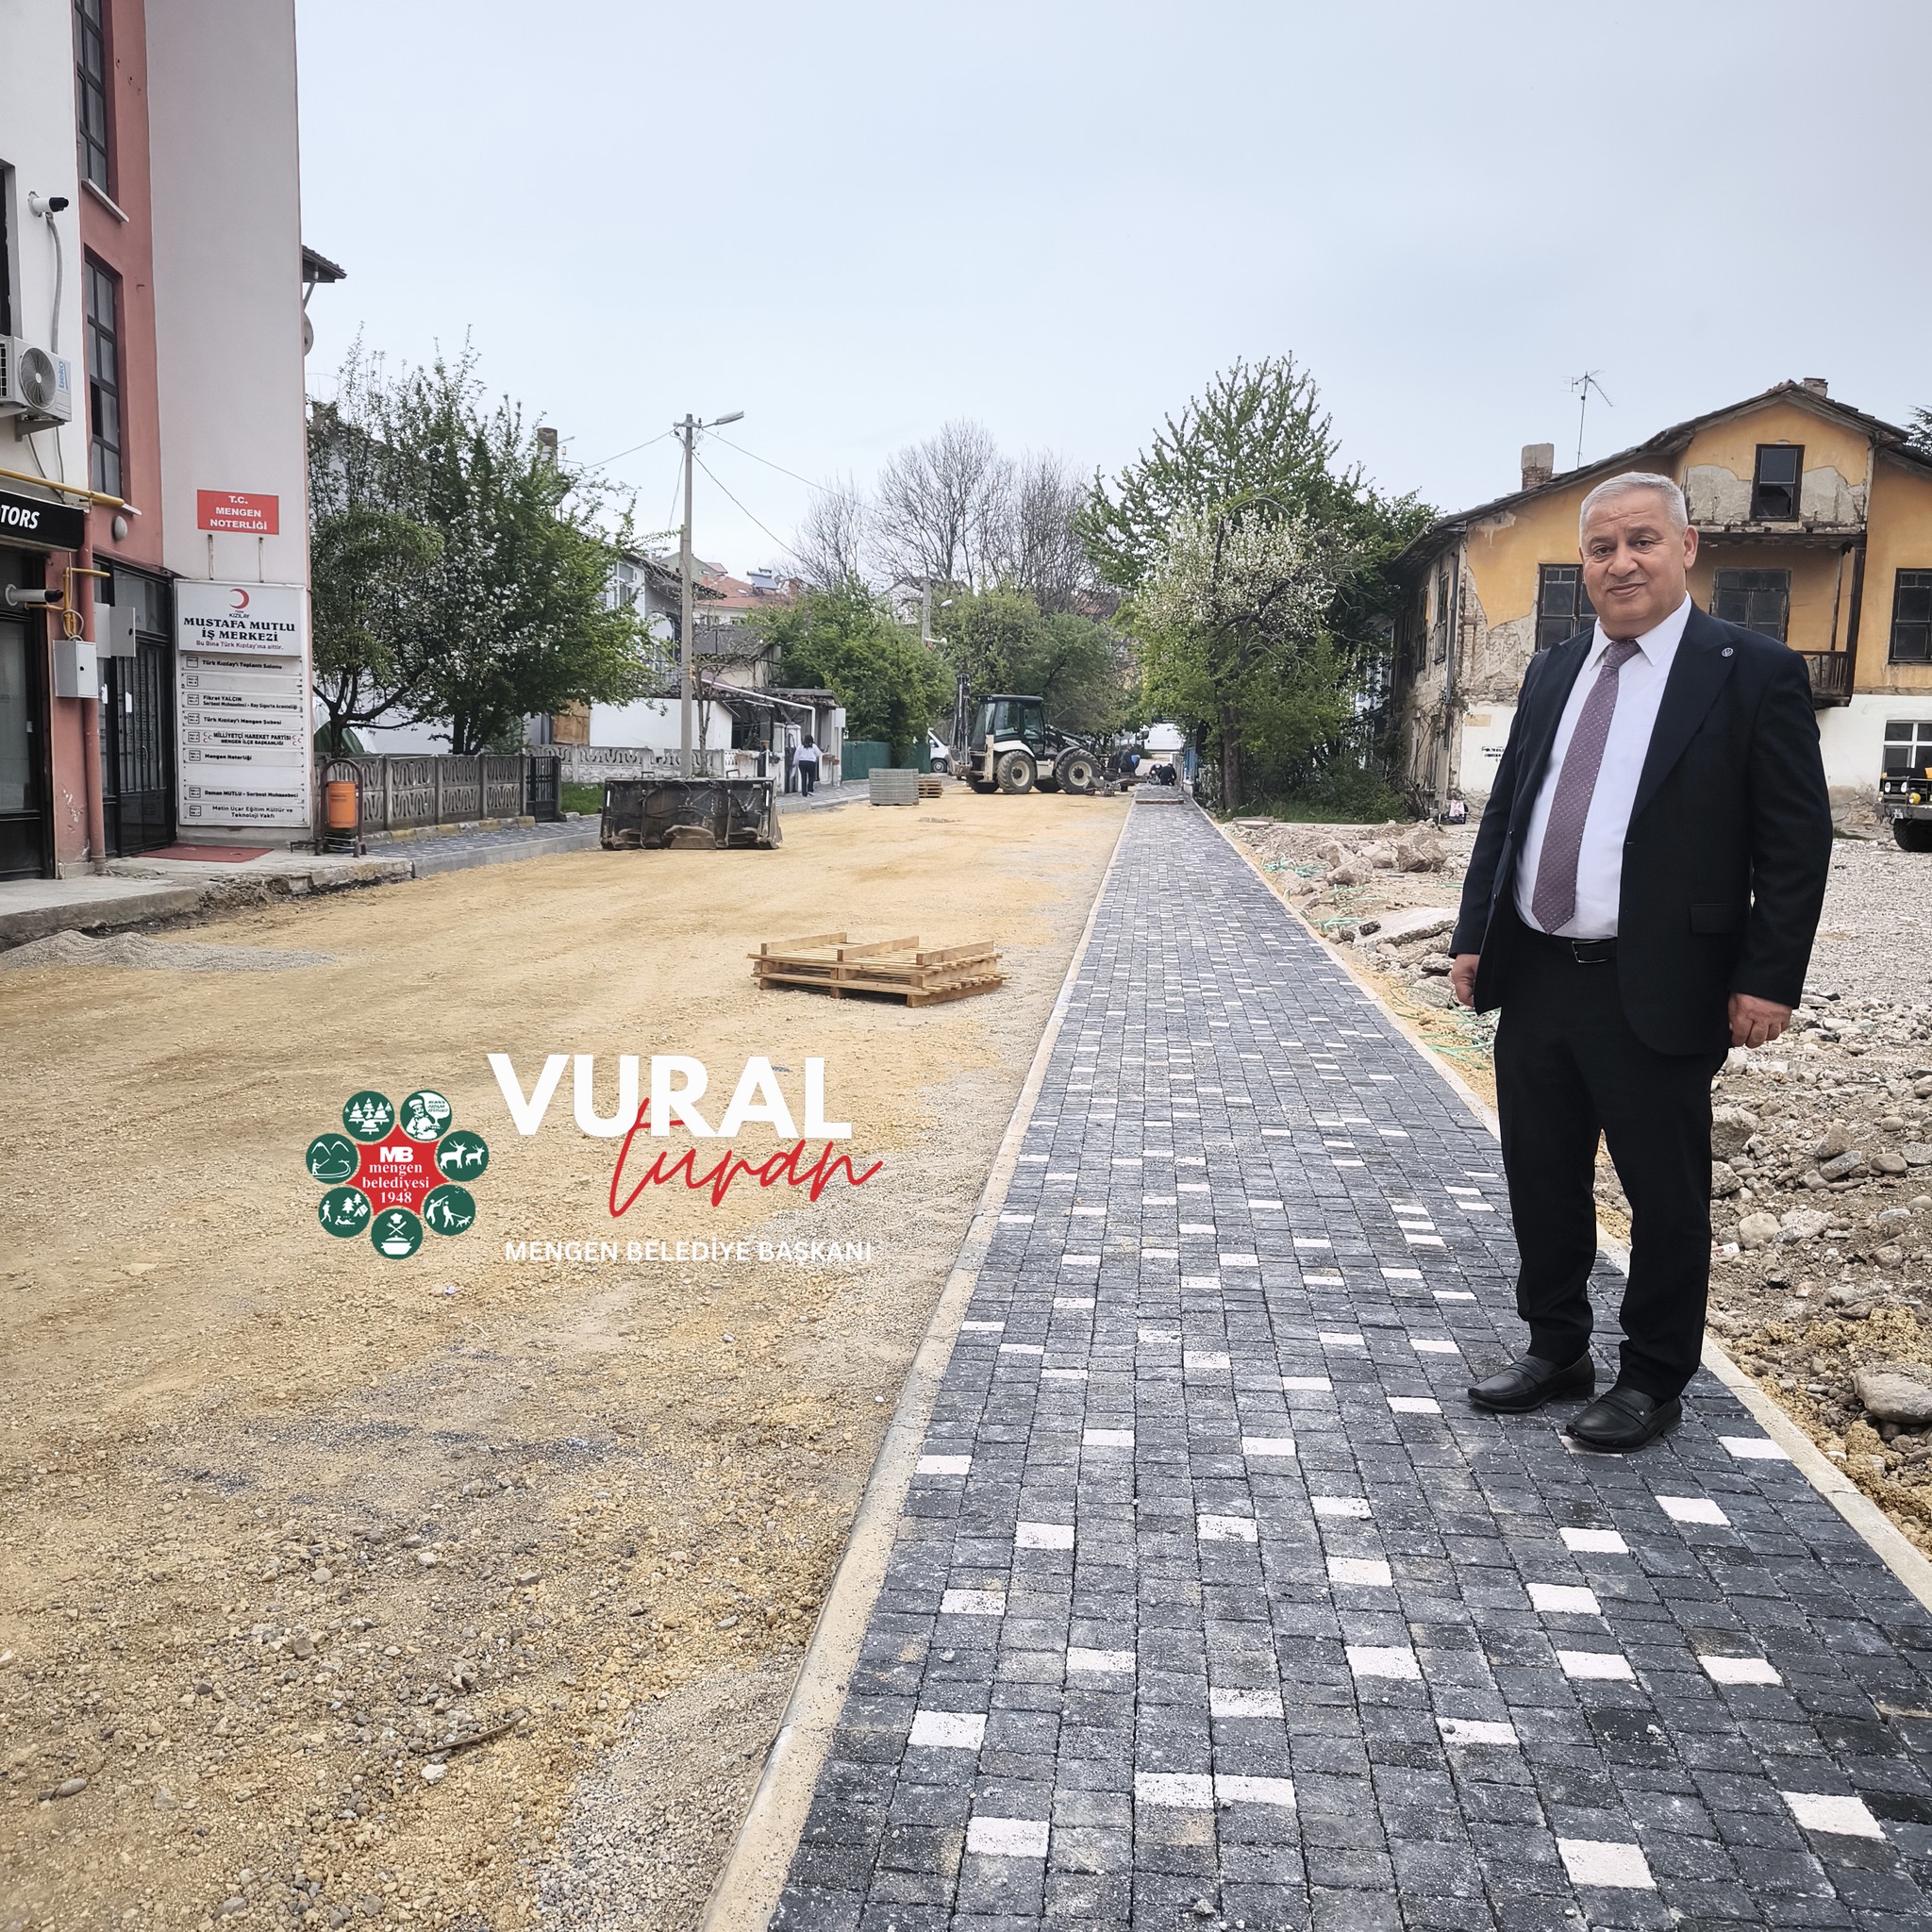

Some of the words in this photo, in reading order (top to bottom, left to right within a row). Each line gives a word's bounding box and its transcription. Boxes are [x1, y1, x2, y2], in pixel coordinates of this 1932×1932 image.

[228, 495, 248, 505] T.C.
[0, 505, 41, 529] TORS
[215, 507, 261, 518] MENGEN
[209, 519, 268, 530] NOTERLİĞİ
[183, 617, 246, 629] MUSTAFA
[249, 622, 295, 631] MUTLU
[202, 626, 215, 640] İŞ
[219, 630, 278, 641] MERKEZİ
